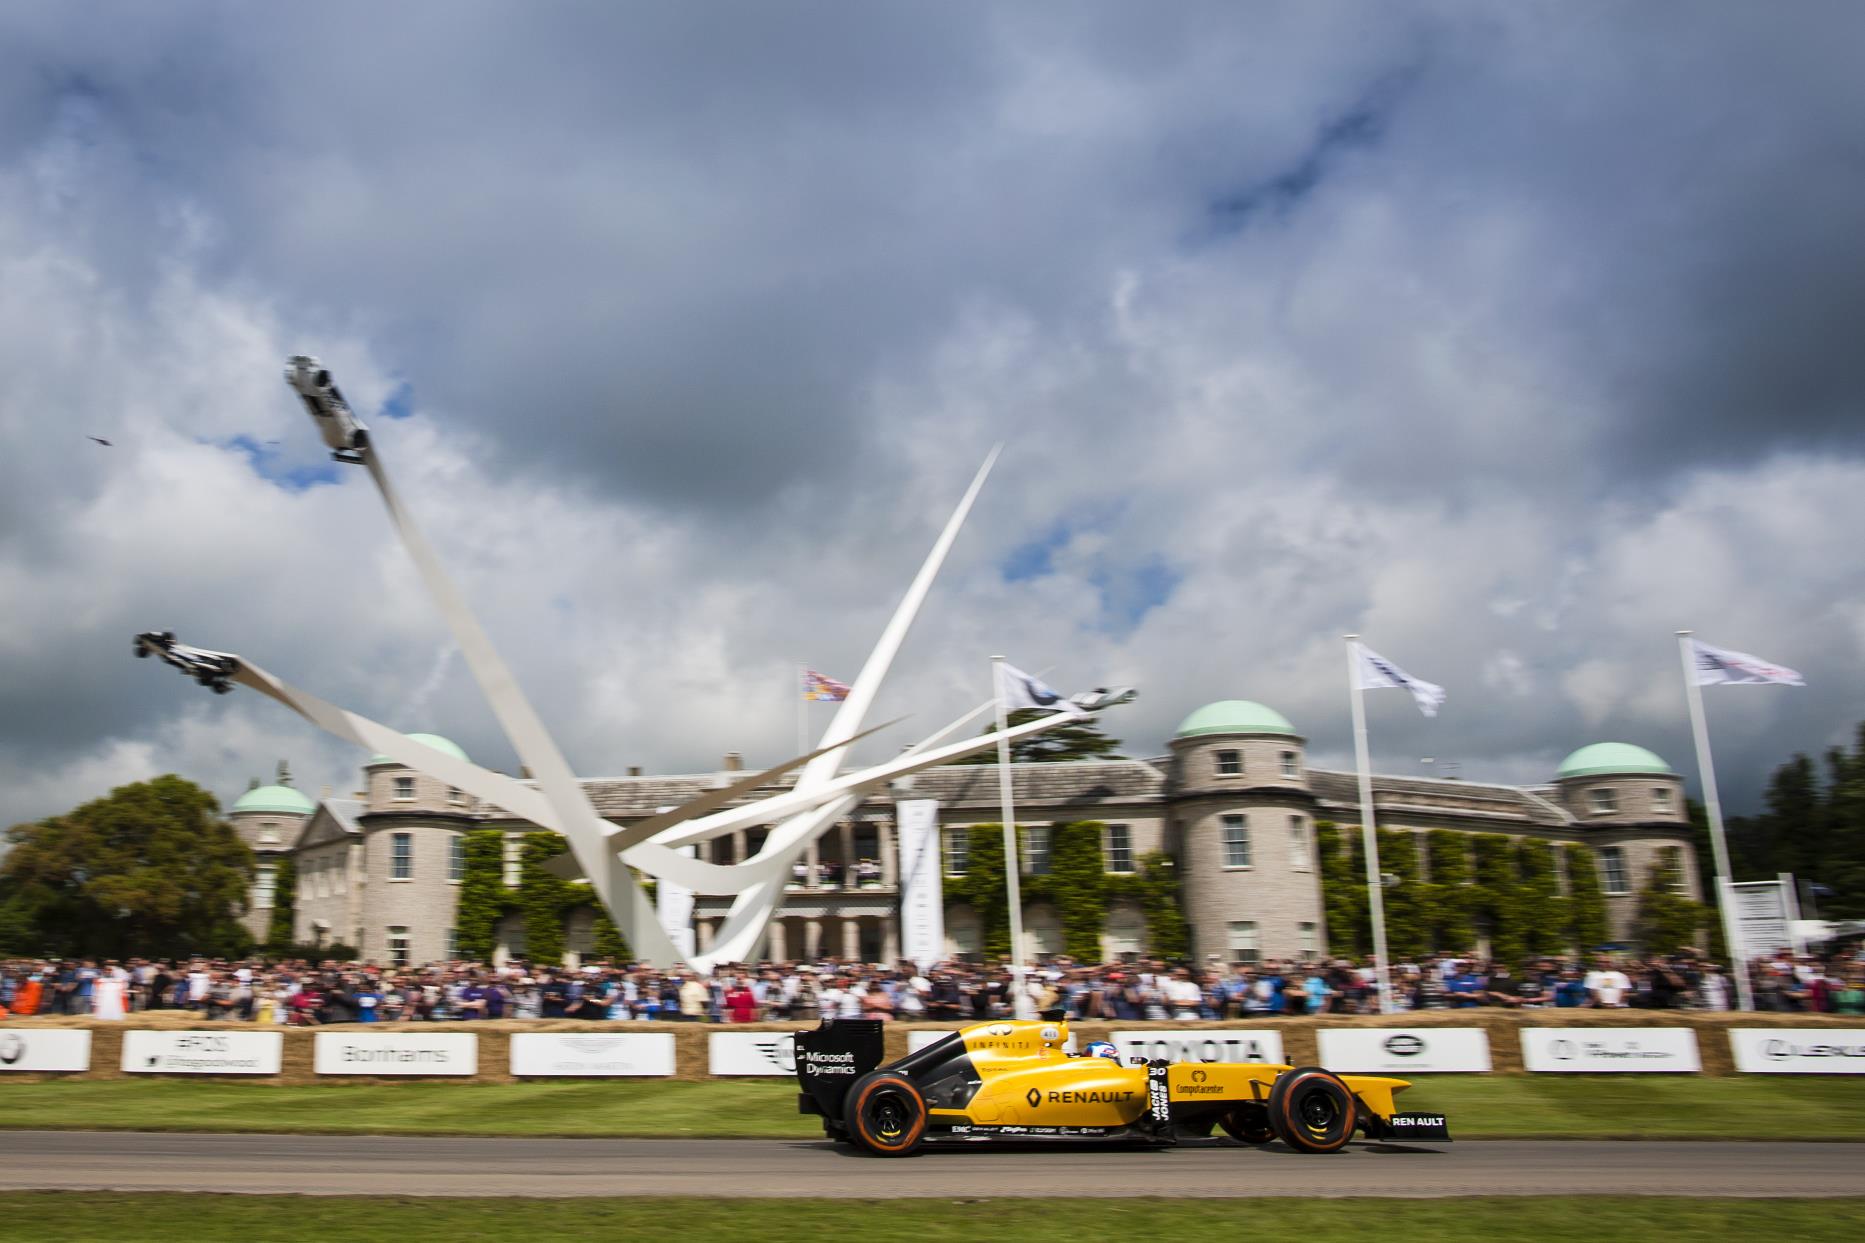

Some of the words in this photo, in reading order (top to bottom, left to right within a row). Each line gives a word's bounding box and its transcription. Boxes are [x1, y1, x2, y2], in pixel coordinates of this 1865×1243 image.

[973, 1042, 1030, 1050] INFINITI
[1128, 1040, 1265, 1063] TOYOTA
[806, 1052, 854, 1063] Microsoft
[806, 1063, 856, 1076] Dynamics
[1149, 1067, 1166, 1076] 30
[1047, 1091, 1134, 1103] RENAULT
[1158, 1085, 1169, 1121] JONES
